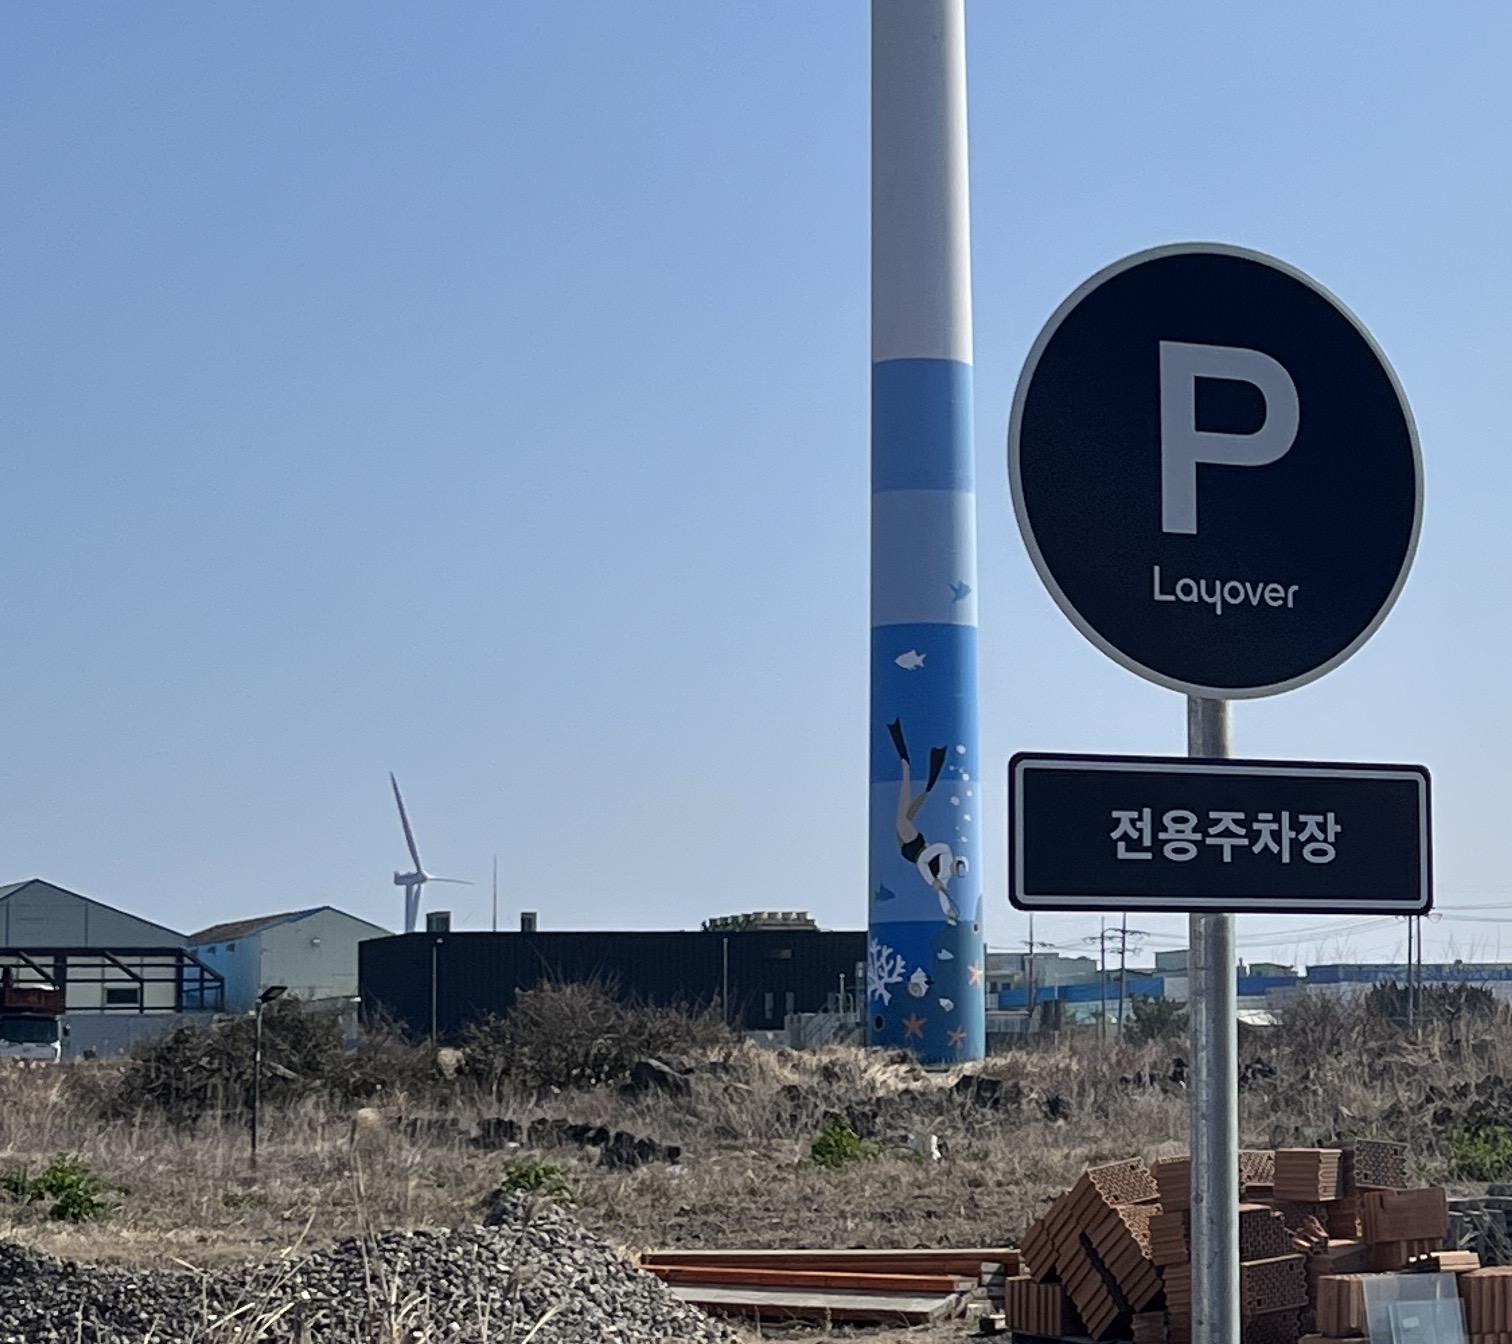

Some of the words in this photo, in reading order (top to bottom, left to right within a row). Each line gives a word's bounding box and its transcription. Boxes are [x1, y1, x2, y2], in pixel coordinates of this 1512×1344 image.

[1160, 340, 1300, 535] P
[1153, 565, 1299, 615] Layover
[1110, 807, 1342, 864] 전용주차장
